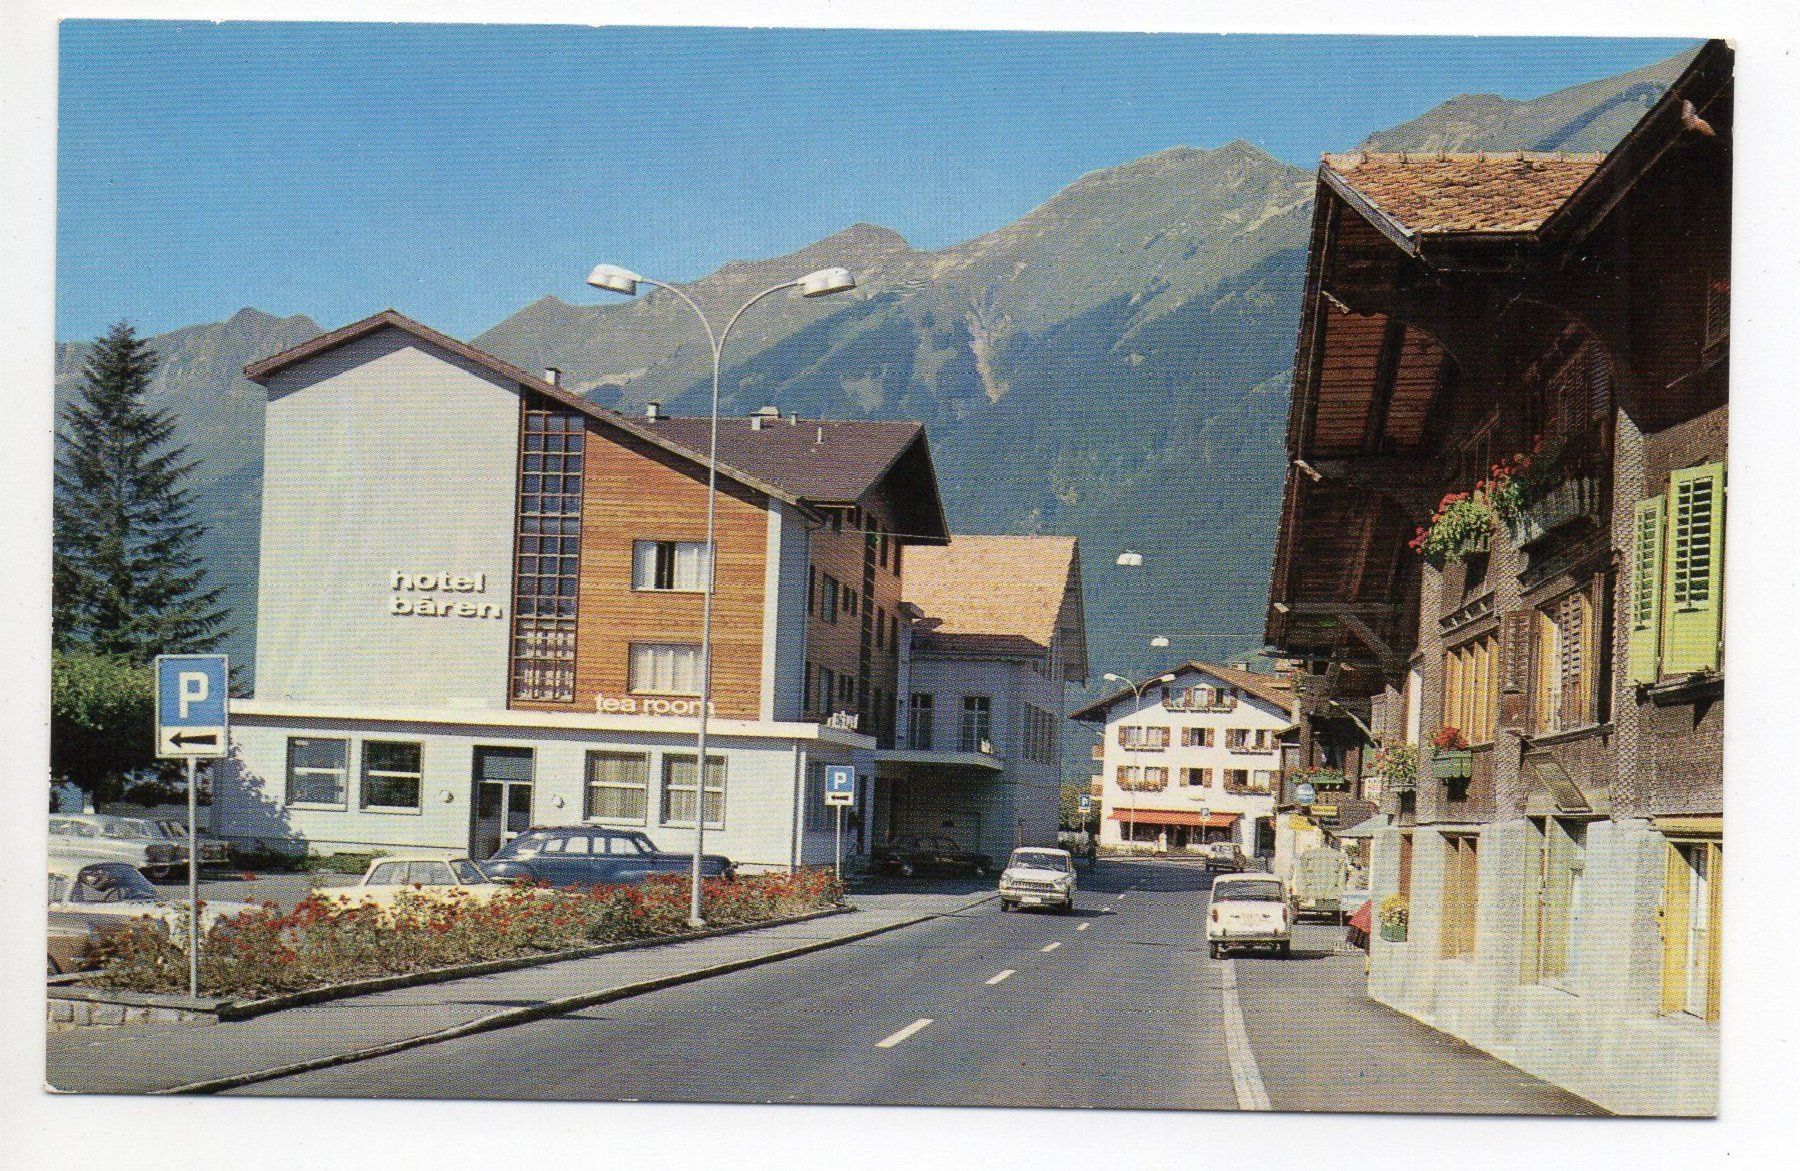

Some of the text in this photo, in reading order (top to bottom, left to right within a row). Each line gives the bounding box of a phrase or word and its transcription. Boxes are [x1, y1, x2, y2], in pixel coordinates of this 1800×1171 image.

[390, 570, 485, 593] hotel
[390, 594, 502, 618] bären
[179, 672, 208, 719] P
[595, 693, 716, 715] tea room
[834, 771, 847, 790] P
